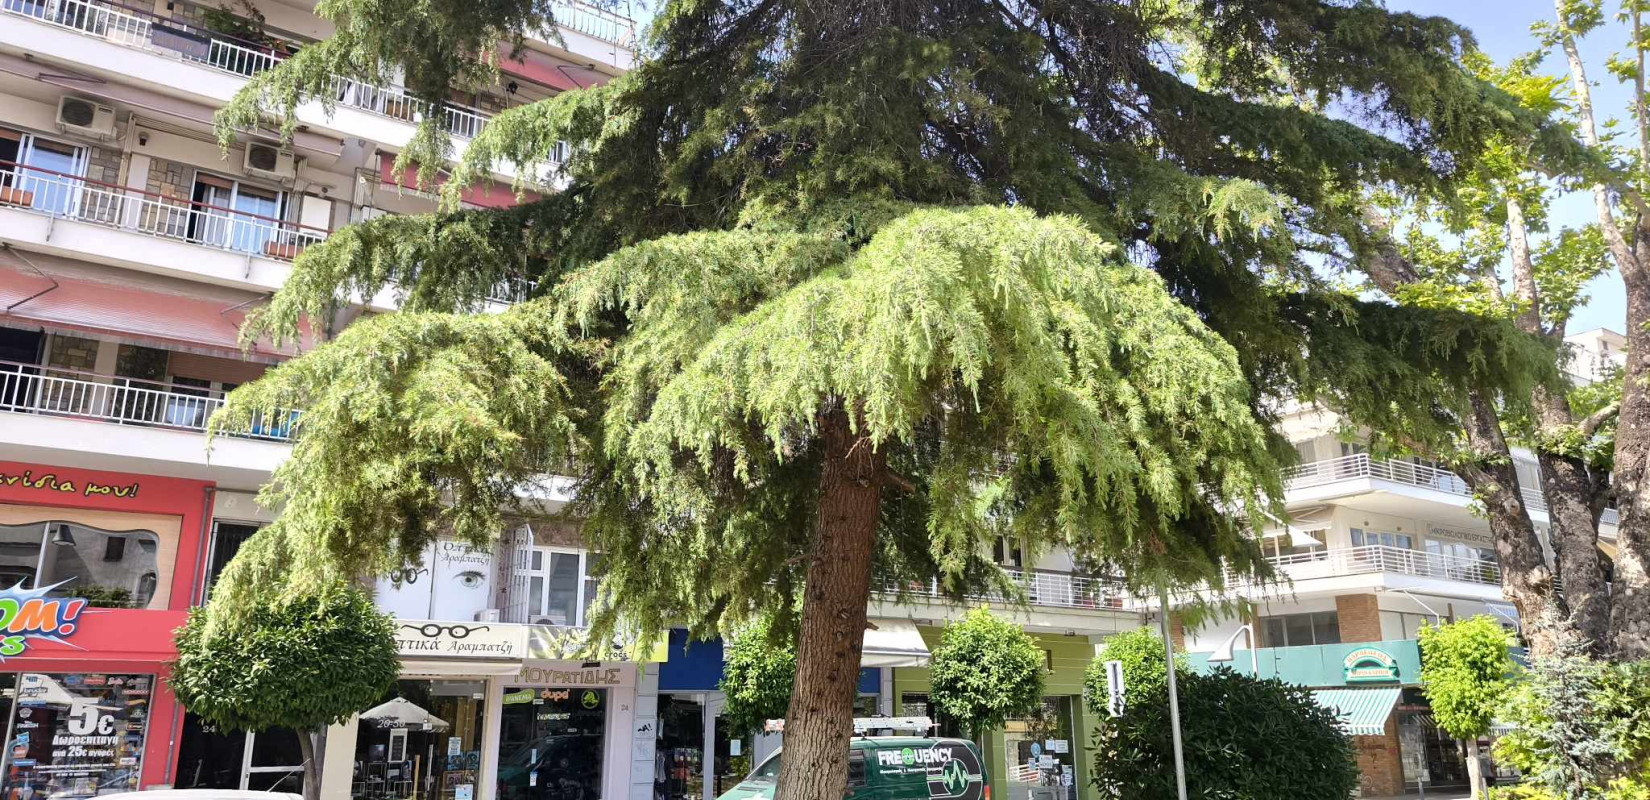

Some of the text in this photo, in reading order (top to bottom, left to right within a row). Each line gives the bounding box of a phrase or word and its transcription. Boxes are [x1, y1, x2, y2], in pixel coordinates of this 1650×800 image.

[396, 637, 514, 655] πτικά Αραμπατζή
[202, 725, 216, 733] 24
